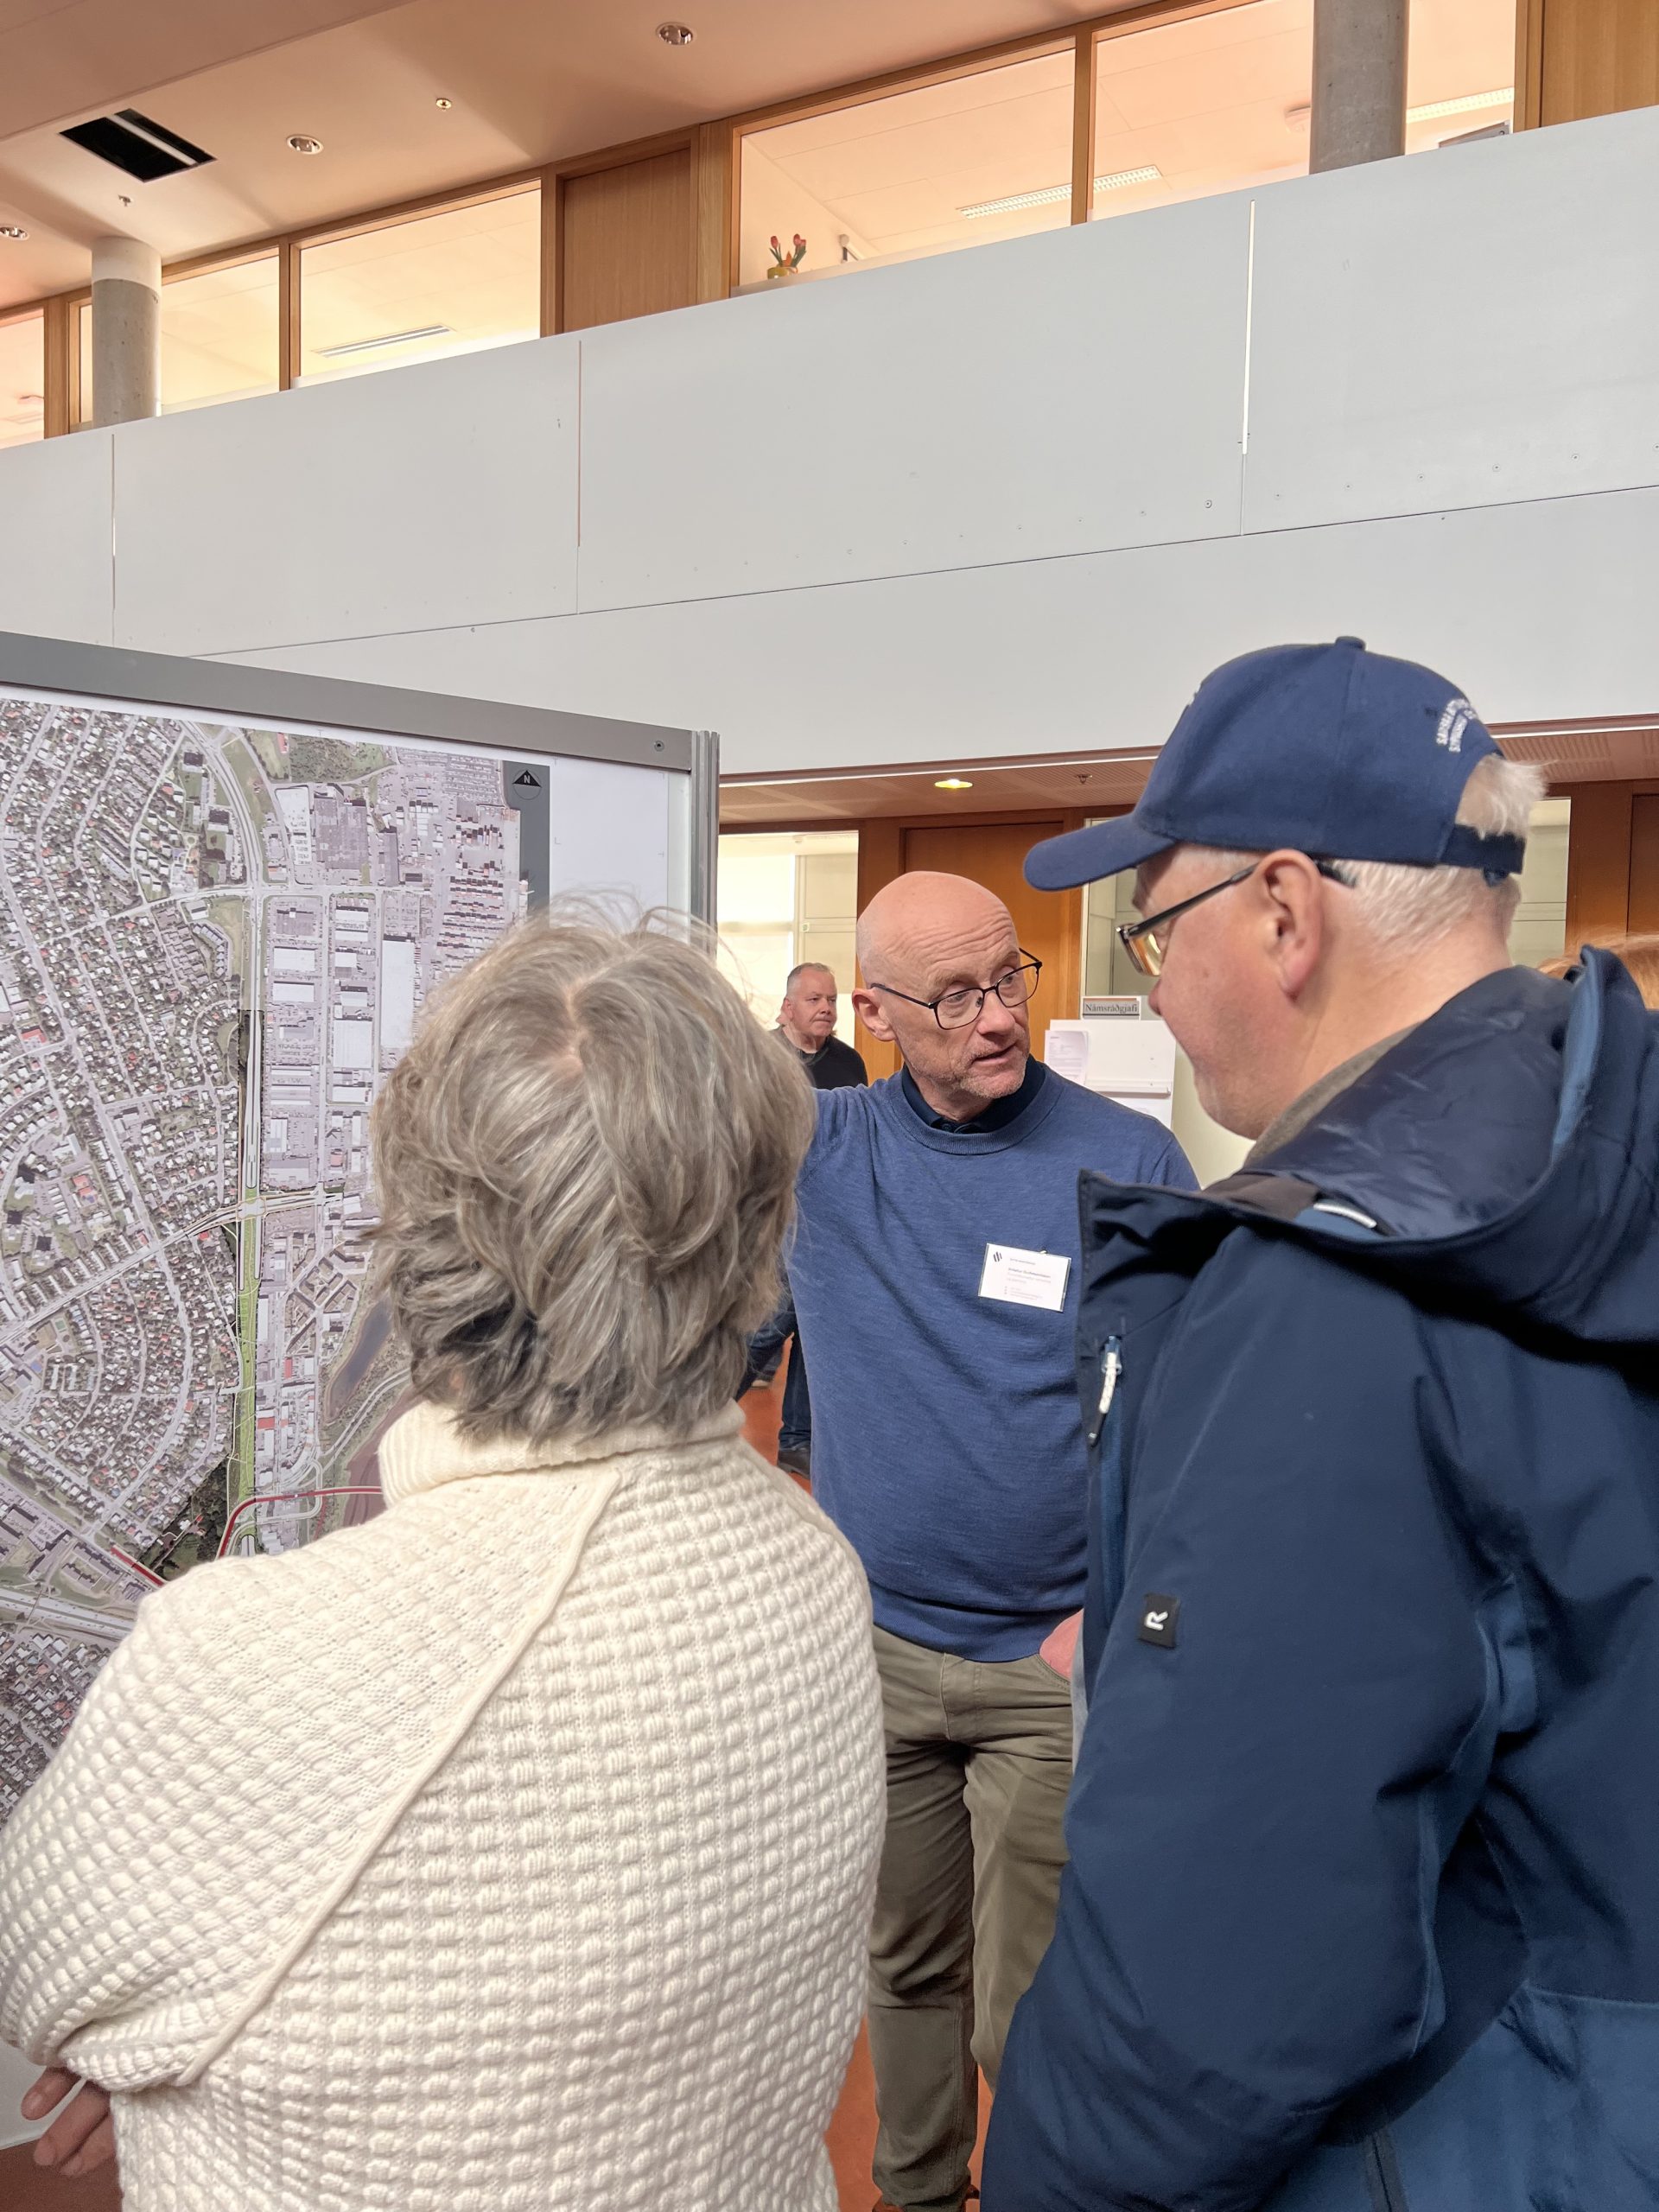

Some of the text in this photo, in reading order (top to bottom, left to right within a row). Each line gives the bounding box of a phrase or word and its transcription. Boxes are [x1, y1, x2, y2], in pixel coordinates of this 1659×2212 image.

[524, 775, 531, 784] N
[1085, 1003, 1137, 1014] Námsráðgjafi
[1145, 1611, 1168, 1630] R
